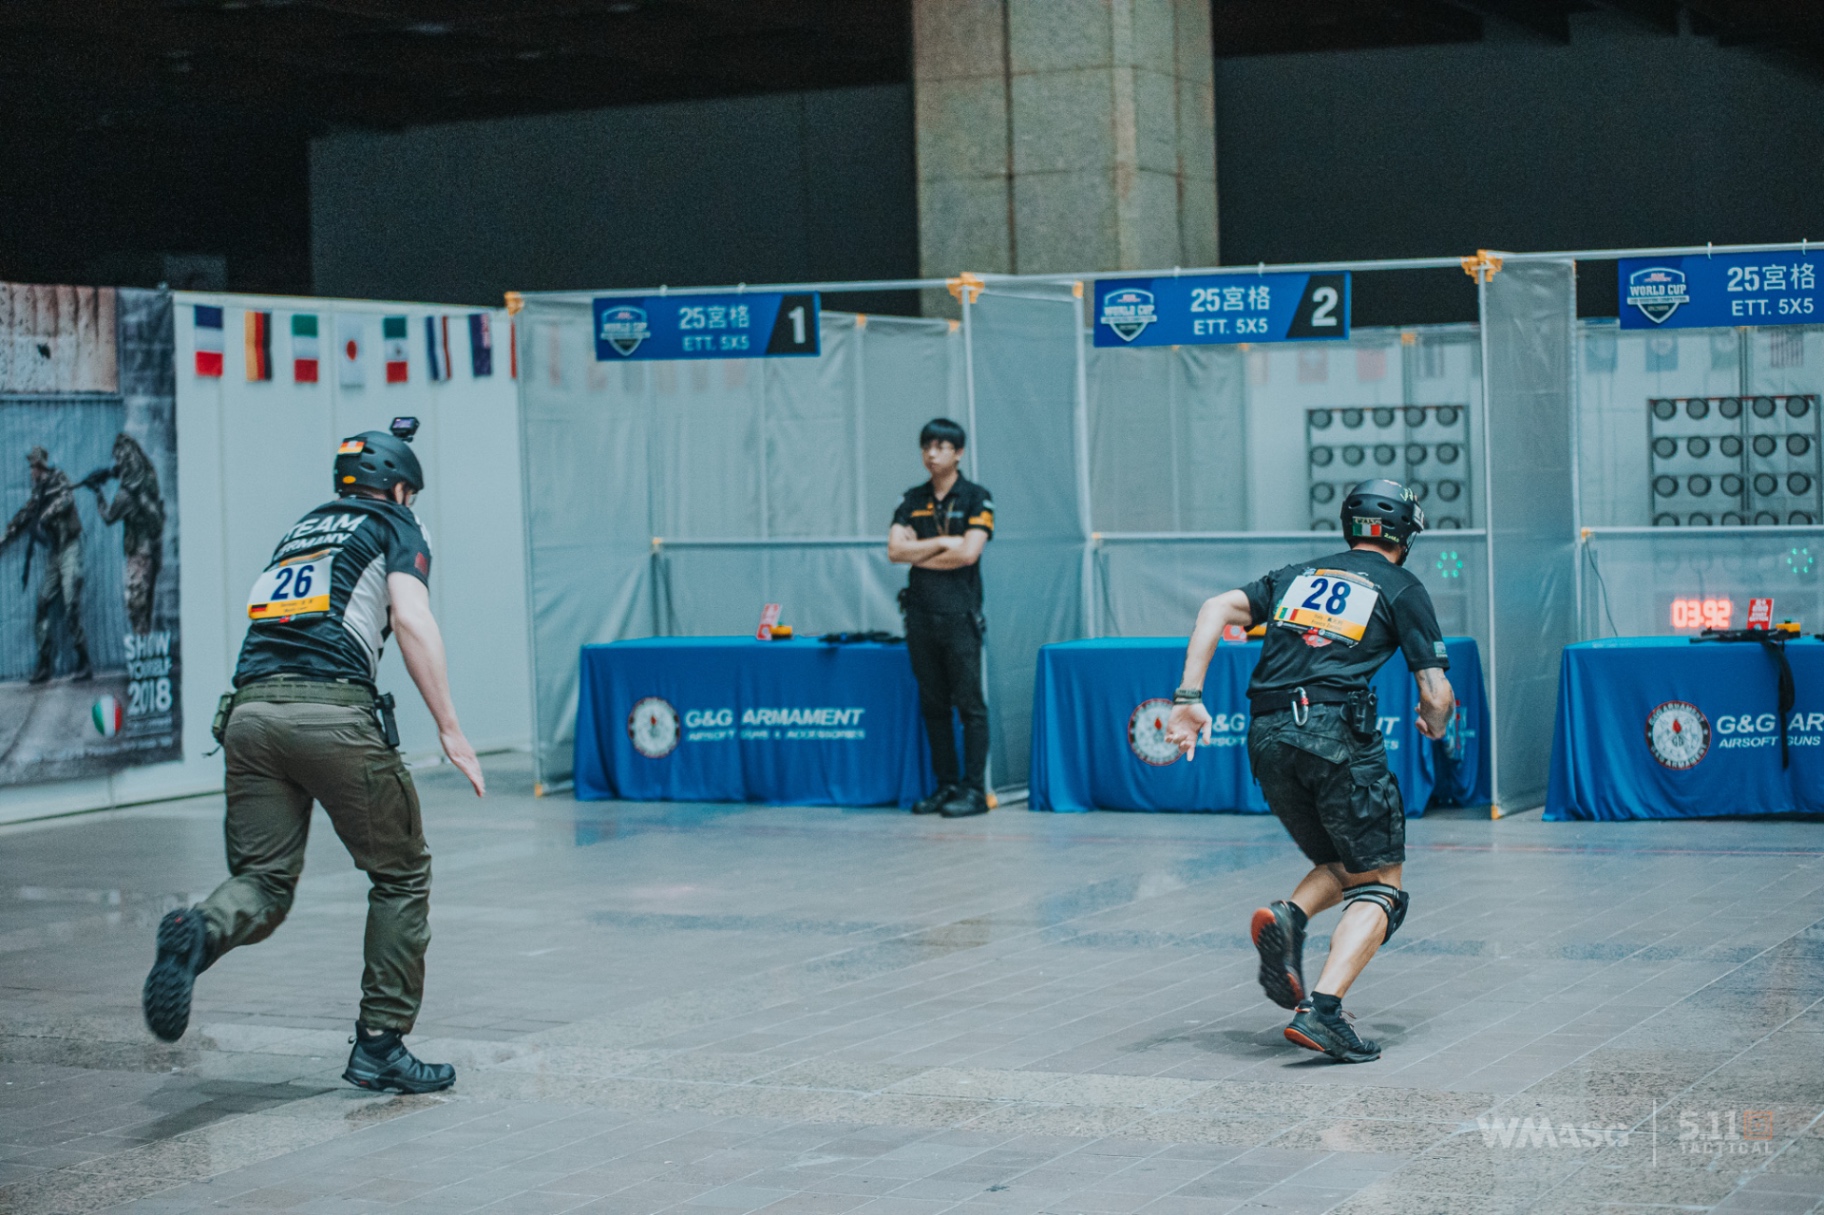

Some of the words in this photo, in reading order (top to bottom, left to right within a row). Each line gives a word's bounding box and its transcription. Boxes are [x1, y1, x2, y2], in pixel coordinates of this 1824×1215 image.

[1630, 285, 1665, 296] WORLD
[1668, 284, 1686, 295] CUP
[1727, 263, 1815, 292] 25宮格
[1190, 286, 1270, 312] 25宮格
[1311, 286, 1338, 327] 2
[1732, 299, 1771, 316] ETT.
[1778, 298, 1814, 315] 5X5
[789, 306, 806, 344] 1
[1194, 319, 1230, 335] ETT.
[1236, 318, 1268, 334] 5X5
[720, 335, 749, 350] 5X5
[284, 514, 369, 541] TEAM
[271, 565, 315, 600] 26
[1301, 578, 1351, 615] 28
[123, 630, 171, 660] SHOW
[127, 677, 173, 716] 2018
[685, 708, 733, 728] G&G
[742, 708, 865, 726] ARMAMENT
[1212, 713, 1246, 732] &G
[1716, 713, 1776, 734] G&G
[1719, 735, 1779, 749] AIRSOFT
